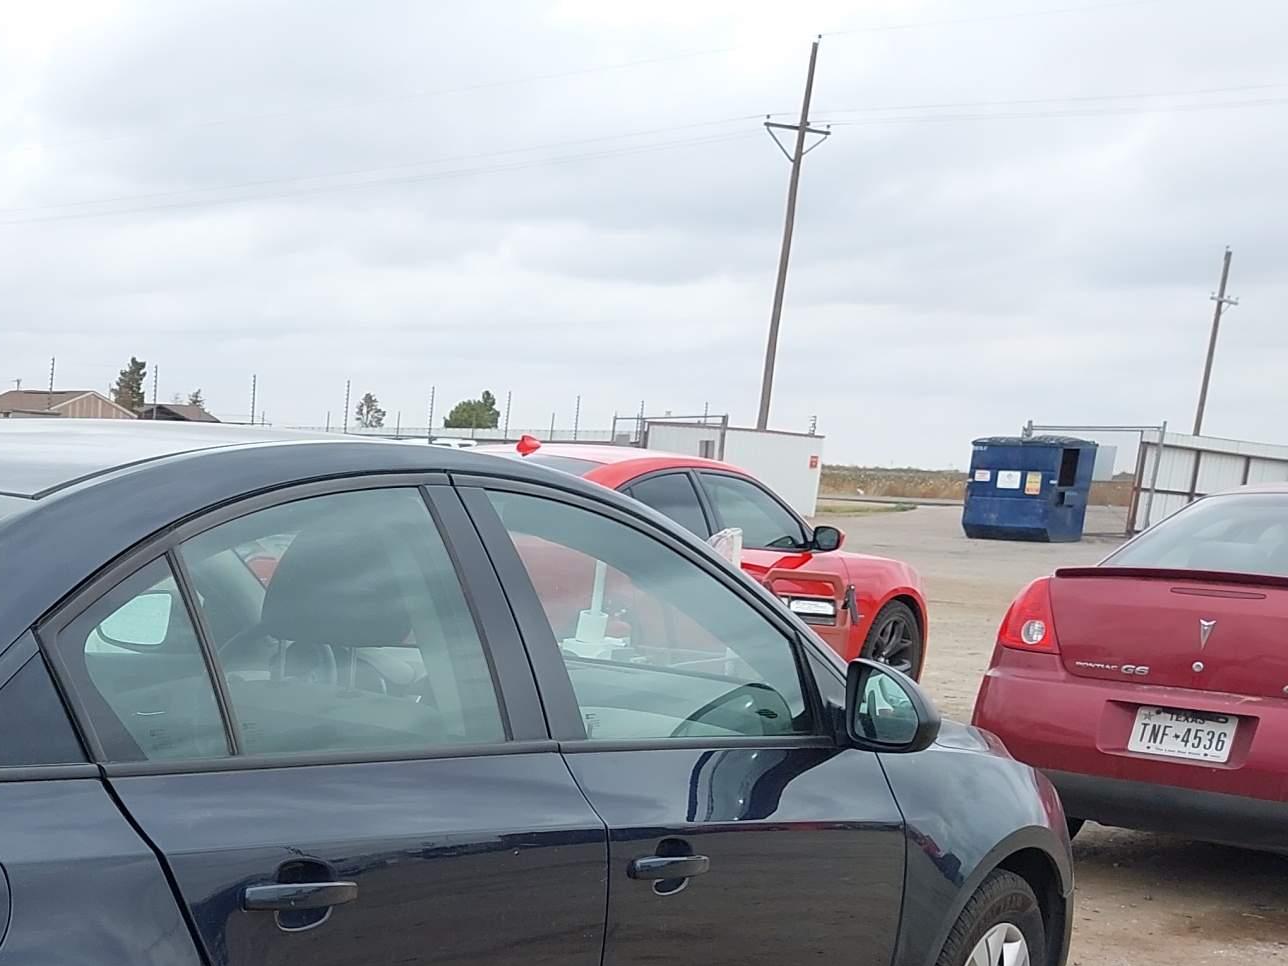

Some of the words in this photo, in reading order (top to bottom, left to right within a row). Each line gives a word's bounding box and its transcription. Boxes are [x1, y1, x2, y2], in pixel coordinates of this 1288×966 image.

[1169, 711, 1206, 725] TEXAS
[1139, 722, 1173, 745] TNF
[1180, 727, 1227, 752] 4536
